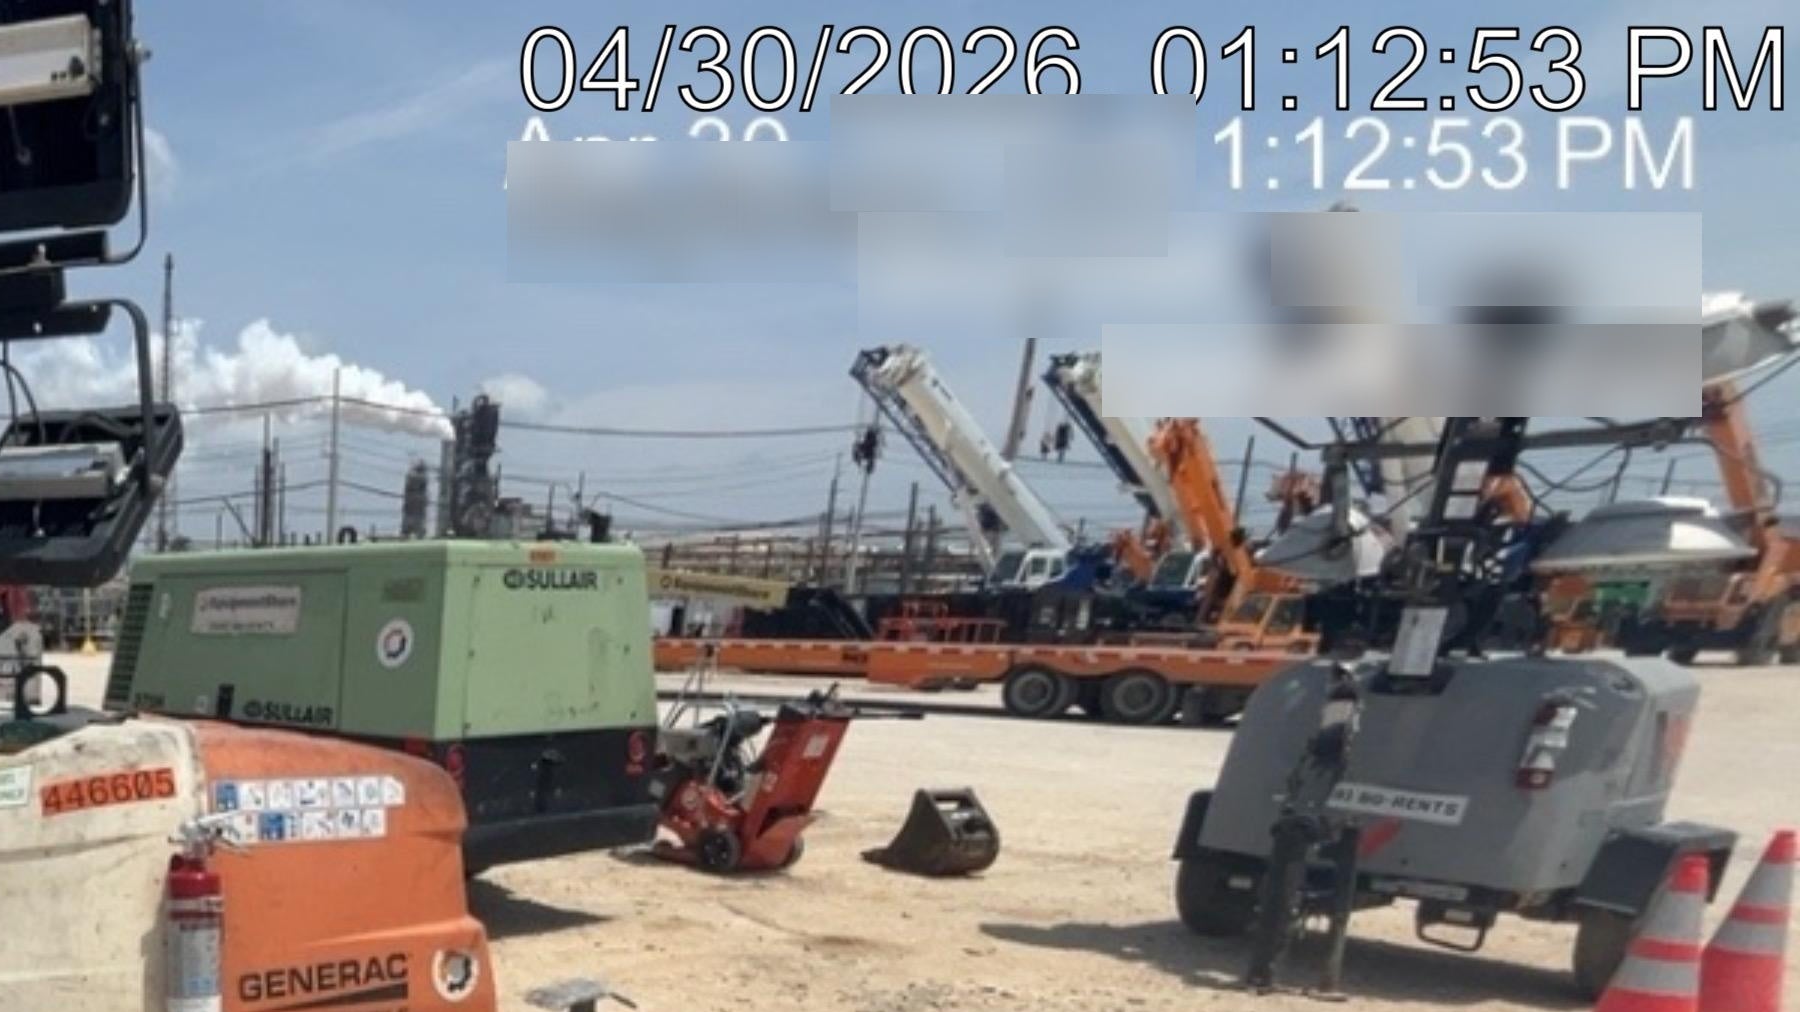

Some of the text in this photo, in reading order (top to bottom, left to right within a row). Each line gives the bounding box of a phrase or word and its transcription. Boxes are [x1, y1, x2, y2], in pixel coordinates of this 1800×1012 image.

[526, 570, 599, 590] SULLAIR
[263, 702, 334, 725] SULLAIR
[42, 768, 177, 815] 446605
[238, 953, 409, 1002] GENERAC
